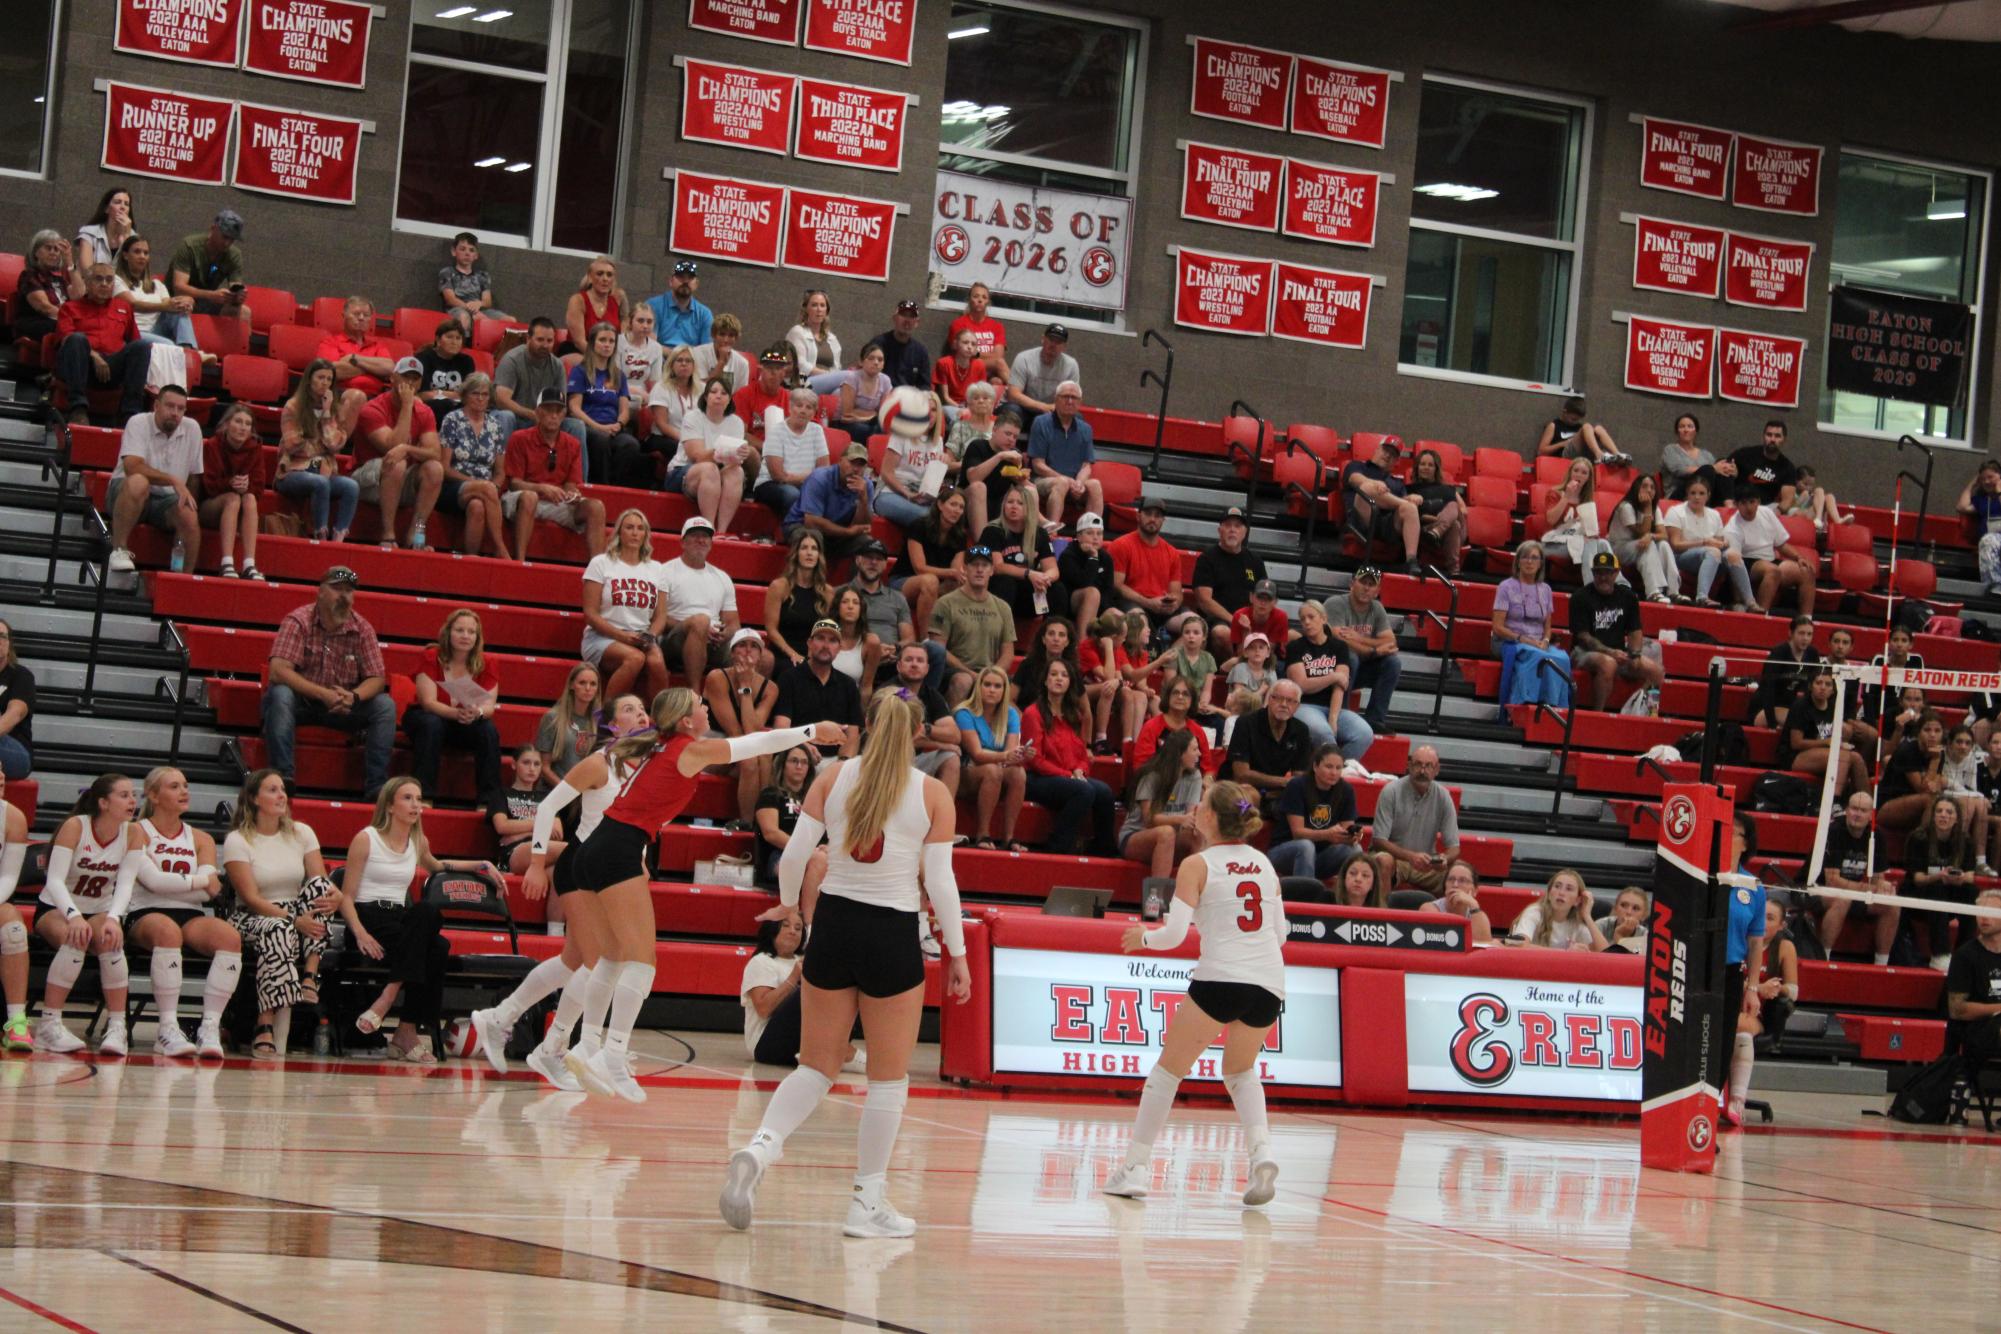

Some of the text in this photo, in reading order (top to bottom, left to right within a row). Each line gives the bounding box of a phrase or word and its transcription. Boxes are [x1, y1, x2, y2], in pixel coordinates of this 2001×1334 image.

[289, 1, 326, 18] STATE
[708, 1, 753, 19] MARCHING
[756, 10, 780, 24] BAND
[149, 10, 207, 31] 2020 AAA
[262, 5, 353, 44] CHAMPIONS
[729, 17, 755, 30] EATON
[146, 23, 208, 43] VOLLEYBALL
[833, 22, 886, 42] BOYS TRACK
[161, 38, 190, 52] EATON
[283, 32, 327, 50] 2021 AA
[846, 36, 872, 49] EATON
[280, 45, 328, 63] FOOTBALL
[1230, 51, 1261, 67] STATE
[289, 58, 317, 72] EATON
[1207, 55, 1280, 90] CHAMPIONS
[725, 73, 759, 88] STATE
[1328, 72, 1358, 87] STATE
[699, 76, 782, 112] CHAMPIONS
[838, 91, 871, 107] STATE
[1222, 91, 1261, 107] FOOTBALL
[1305, 74, 1377, 108] CHAMPIONS
[151, 99, 188, 115] STATE
[811, 95, 898, 131] THIRD PLACE
[1228, 102, 1251, 114] EATON
[1318, 98, 1360, 116] 2023 AAA
[121, 102, 217, 141] RUNNER UP
[281, 117, 318, 135] STATE
[713, 113, 763, 131] WRESTLING
[1319, 110, 1357, 126] BASEBALL
[724, 126, 749, 139] EATON
[1327, 123, 1348, 135] EATON
[139, 130, 194, 149] 2021 AAA
[252, 123, 344, 161] FINAL FOUR
[814, 130, 887, 151] MARCHING BAND
[1651, 132, 1723, 164] FINAL FOUR
[137, 141, 194, 162] WRESTLING
[270, 148, 322, 168] 2021 AAA
[837, 145, 862, 157] EATON
[148, 156, 177, 171] EATON
[271, 161, 320, 180] SOFTBALL
[1220, 156, 1250, 170] STATE
[1746, 152, 1811, 178] CHAMPIONS
[279, 175, 308, 189] EATON
[1195, 158, 1271, 194] FINAL FOUR
[1317, 174, 1348, 188] STATE
[1674, 174, 1694, 186] EATON
[713, 185, 747, 200] STATE
[1295, 178, 1365, 209] 3RD PLACE
[1760, 182, 1792, 196] SOFTBALL
[688, 189, 771, 225] CHAMPIONS
[826, 201, 859, 216] STATE
[1207, 194, 1254, 211] VOLLEYBALL
[1307, 200, 1349, 217] 2023 AAA
[938, 191, 1120, 243] CLASS OF
[1218, 207, 1241, 219] EATON
[1303, 211, 1352, 229] BOYS TRACK
[800, 204, 882, 240] CHAMPIONS
[1316, 224, 1337, 236] EATON
[704, 227, 748, 243] BASEBALL
[1670, 230, 1692, 241] STATE
[712, 240, 737, 252] EATON
[816, 242, 858, 258] SOFTBALL
[1643, 231, 1716, 262] FINAL FOUR
[823, 255, 848, 267] EATON
[982, 236, 1068, 274] 2026
[1681, 256, 1697, 267] AAA
[1732, 248, 1804, 276] FINAL FOUR
[1210, 262, 1241, 276] STATE
[1659, 263, 1697, 276] VOLLEYBALL
[1186, 264, 1261, 296] CHAMPIONS
[1313, 278, 1336, 289] STATE
[1667, 273, 1688, 284] EATON
[1750, 279, 1785, 292] WRESTLING
[1200, 288, 1244, 305] 2023 AAA
[1282, 280, 1361, 311] FINAL FOUR
[1198, 300, 1243, 316] WRESTLING
[1305, 303, 1338, 316] 2023 AA
[1208, 312, 1231, 325] EATON
[1303, 312, 1336, 326] FOOTBALL
[1868, 309, 1933, 333] EATON
[1308, 324, 1330, 335] EATON
[1659, 328, 1687, 341] STATE
[1637, 330, 1704, 360] CHAMPIONS
[1748, 339, 1776, 352] STATE
[1831, 323, 1964, 357] HIGH SCHOOL
[1649, 353, 1689, 369] 2024 AAA
[1726, 343, 1793, 373] FINAL FOUR
[1851, 346, 1942, 371] CLASS OF
[1651, 366, 1685, 379] BASEBALL
[1762, 367, 1778, 379] AAA
[1873, 367, 1916, 386] 2029
[1658, 377, 1677, 388] EATON
[1904, 670, 2000, 688] EATON REDS
[155, 843, 195, 857] Eaton
[77, 857, 119, 872] Eaton
[1226, 862, 1262, 875] Reds
[72, 874, 109, 898] 18
[1236, 881, 1263, 933] 3
[1292, 924, 1312, 934] BONUS
[1352, 924, 1386, 942] POSS
[1426, 933, 1445, 942] BONUS
[1128, 961, 1192, 981] Welcome
[1645, 900, 1673, 1060] EATON
[1670, 939, 1687, 1024] REDS
[1526, 987, 1605, 1008] Home of the
[1050, 983, 1285, 1053] EAT
[1701, 1013, 1710, 1056] sports
[1063, 1052, 1141, 1073] HIGH
